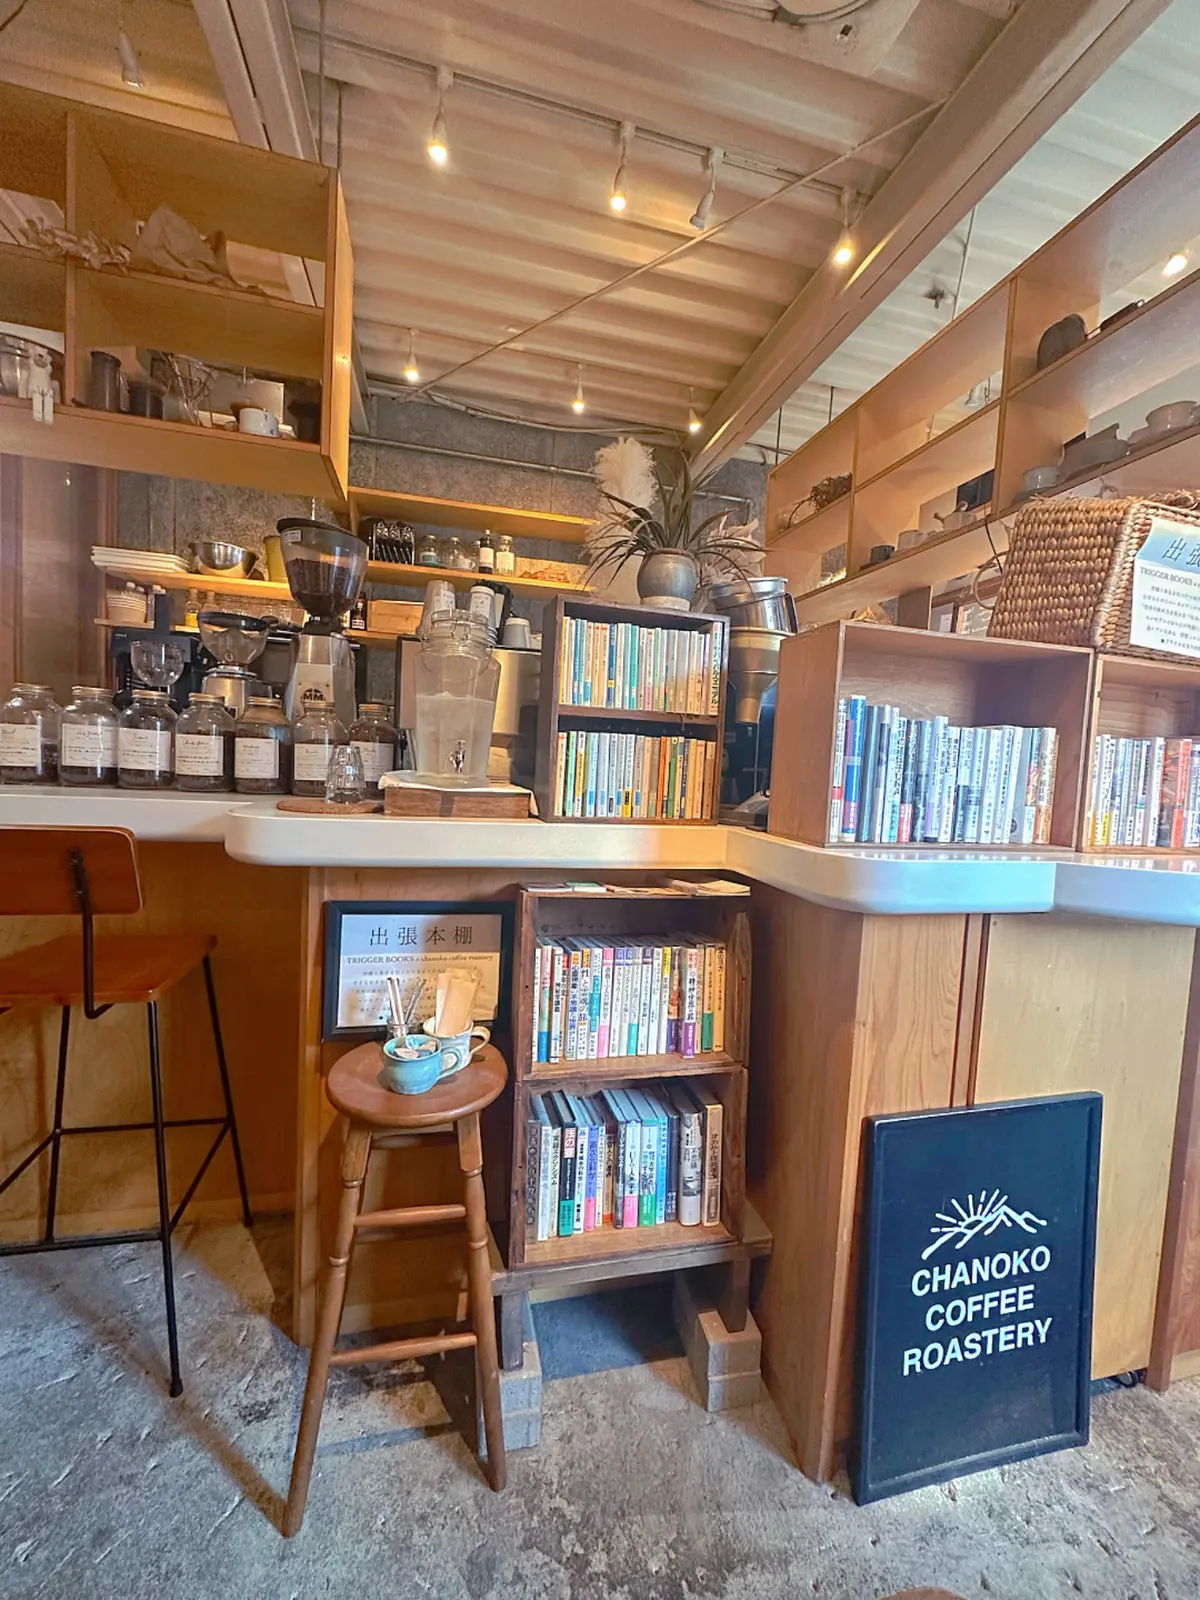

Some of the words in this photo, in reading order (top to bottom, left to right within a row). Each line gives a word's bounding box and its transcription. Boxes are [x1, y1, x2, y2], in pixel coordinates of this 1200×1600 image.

[1140, 566, 1169, 580] TRIGGER
[1170, 574, 1193, 586] BOOKS
[370, 925, 473, 946] 出張本棚
[347, 956, 384, 964] TRIGGER
[386, 955, 414, 963] BOOKS
[449, 954, 467, 962] coffee
[468, 954, 493, 962] roastery
[912, 1245, 1051, 1297] CHANOKO
[925, 1284, 1035, 1332] COFFEE
[902, 1317, 1053, 1377] ROASTERY
